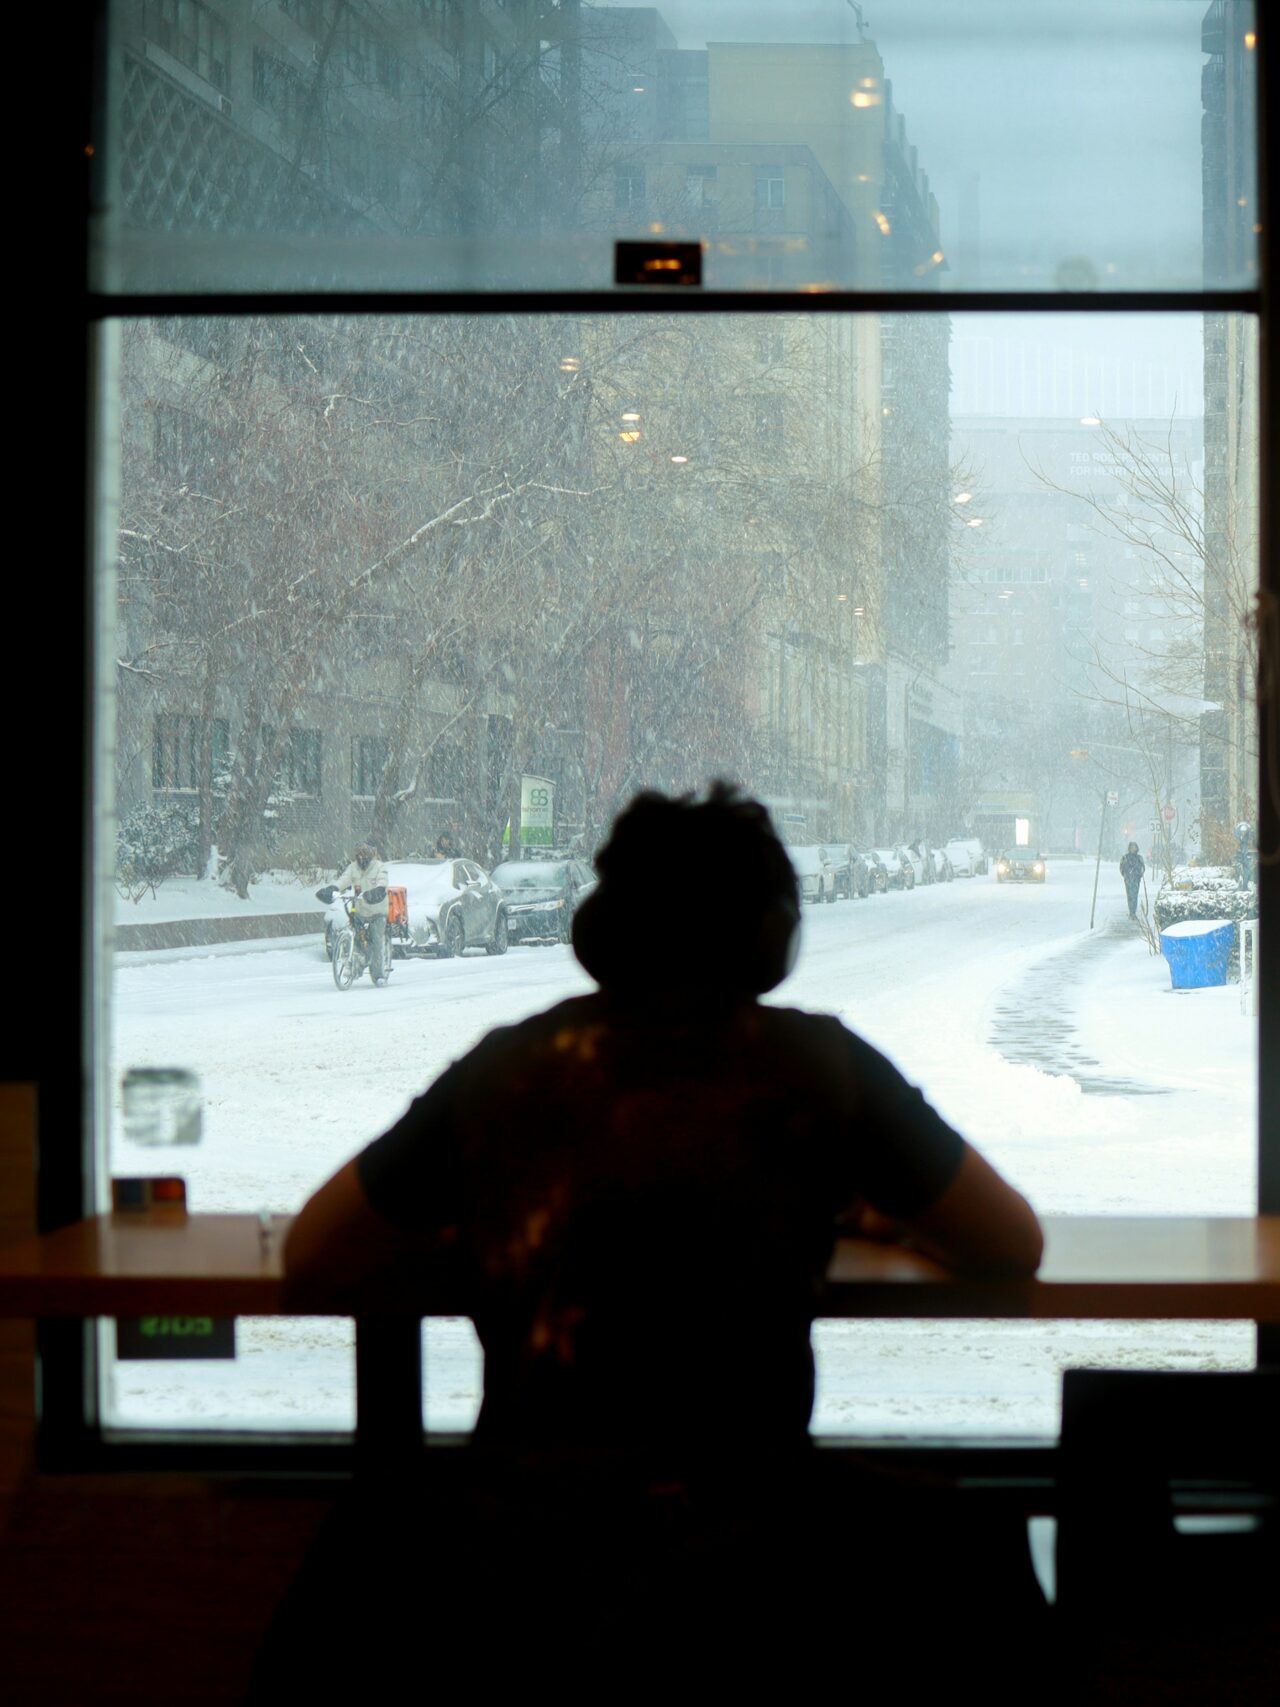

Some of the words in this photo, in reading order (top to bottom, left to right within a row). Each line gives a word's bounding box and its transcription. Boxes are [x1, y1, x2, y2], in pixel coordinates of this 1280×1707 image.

[1069, 452, 1089, 462] TED
[1069, 466, 1091, 476] FOR
[1150, 823, 1162, 832] 30
